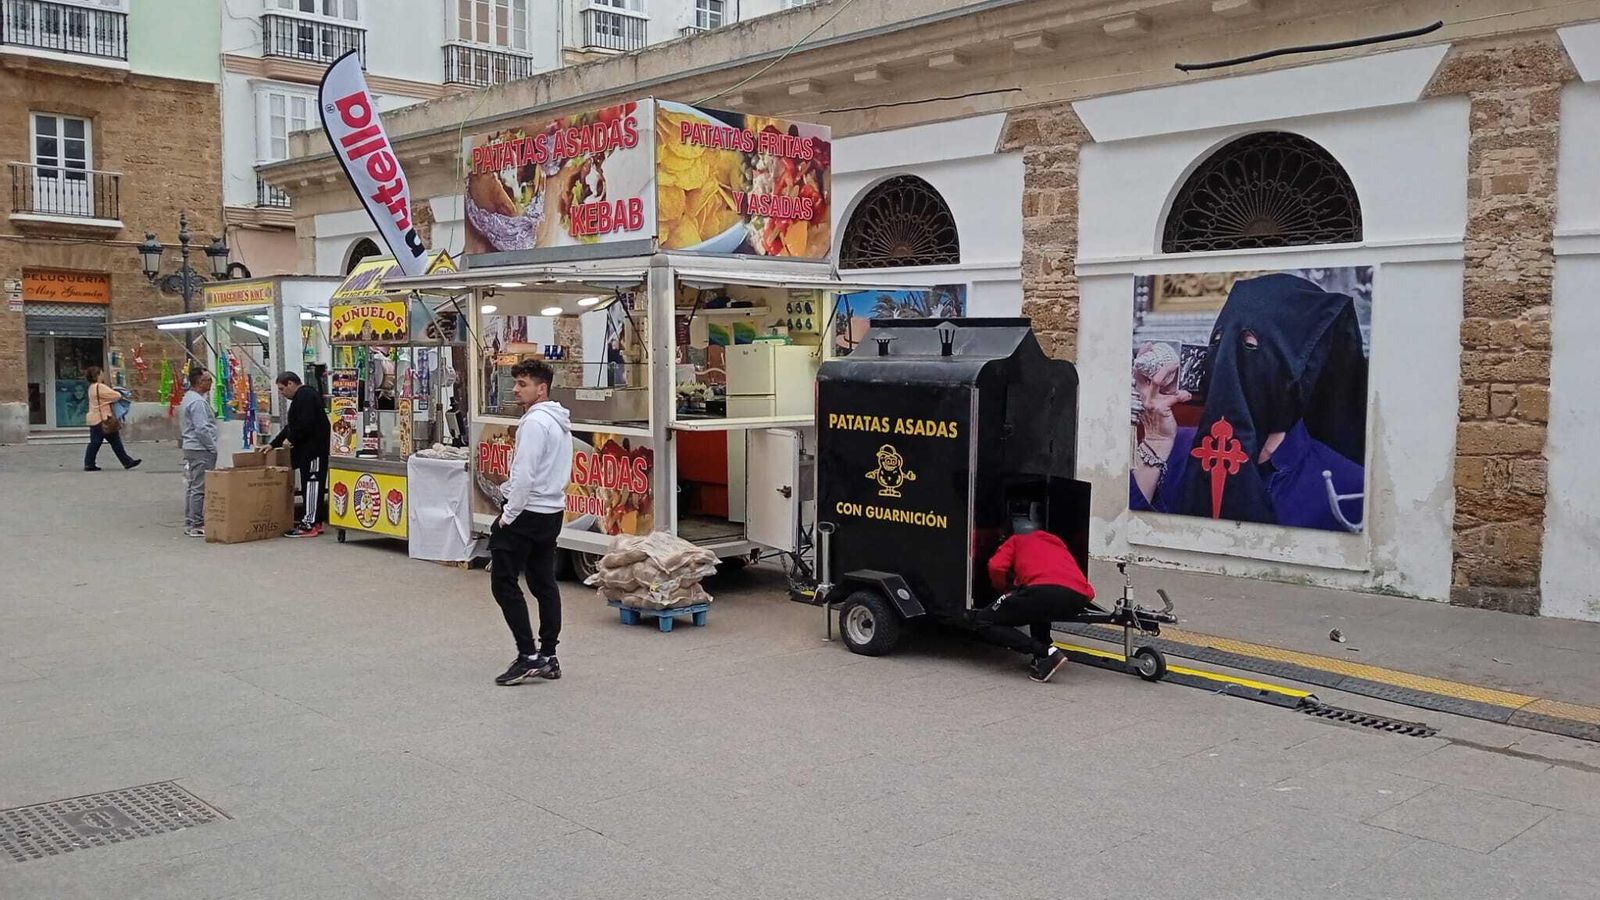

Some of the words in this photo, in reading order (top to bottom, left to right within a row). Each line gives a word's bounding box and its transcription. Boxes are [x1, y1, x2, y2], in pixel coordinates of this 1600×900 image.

[472, 134, 548, 175] PATATAS
[552, 116, 639, 161] ASADAS
[679, 120, 754, 153] PATATAS
[758, 132, 814, 160] FRITAS
[569, 197, 644, 237] KEBAB
[732, 190, 745, 213] Y
[747, 192, 814, 220] ASADAS
[334, 305, 404, 330] BUÑUELOS
[829, 413, 890, 433] PATATAS
[894, 418, 958, 438] ASADAS
[565, 494, 605, 516] NICIÓN
[836, 501, 862, 516] CON
[865, 504, 947, 529] GUARNICIÓN
